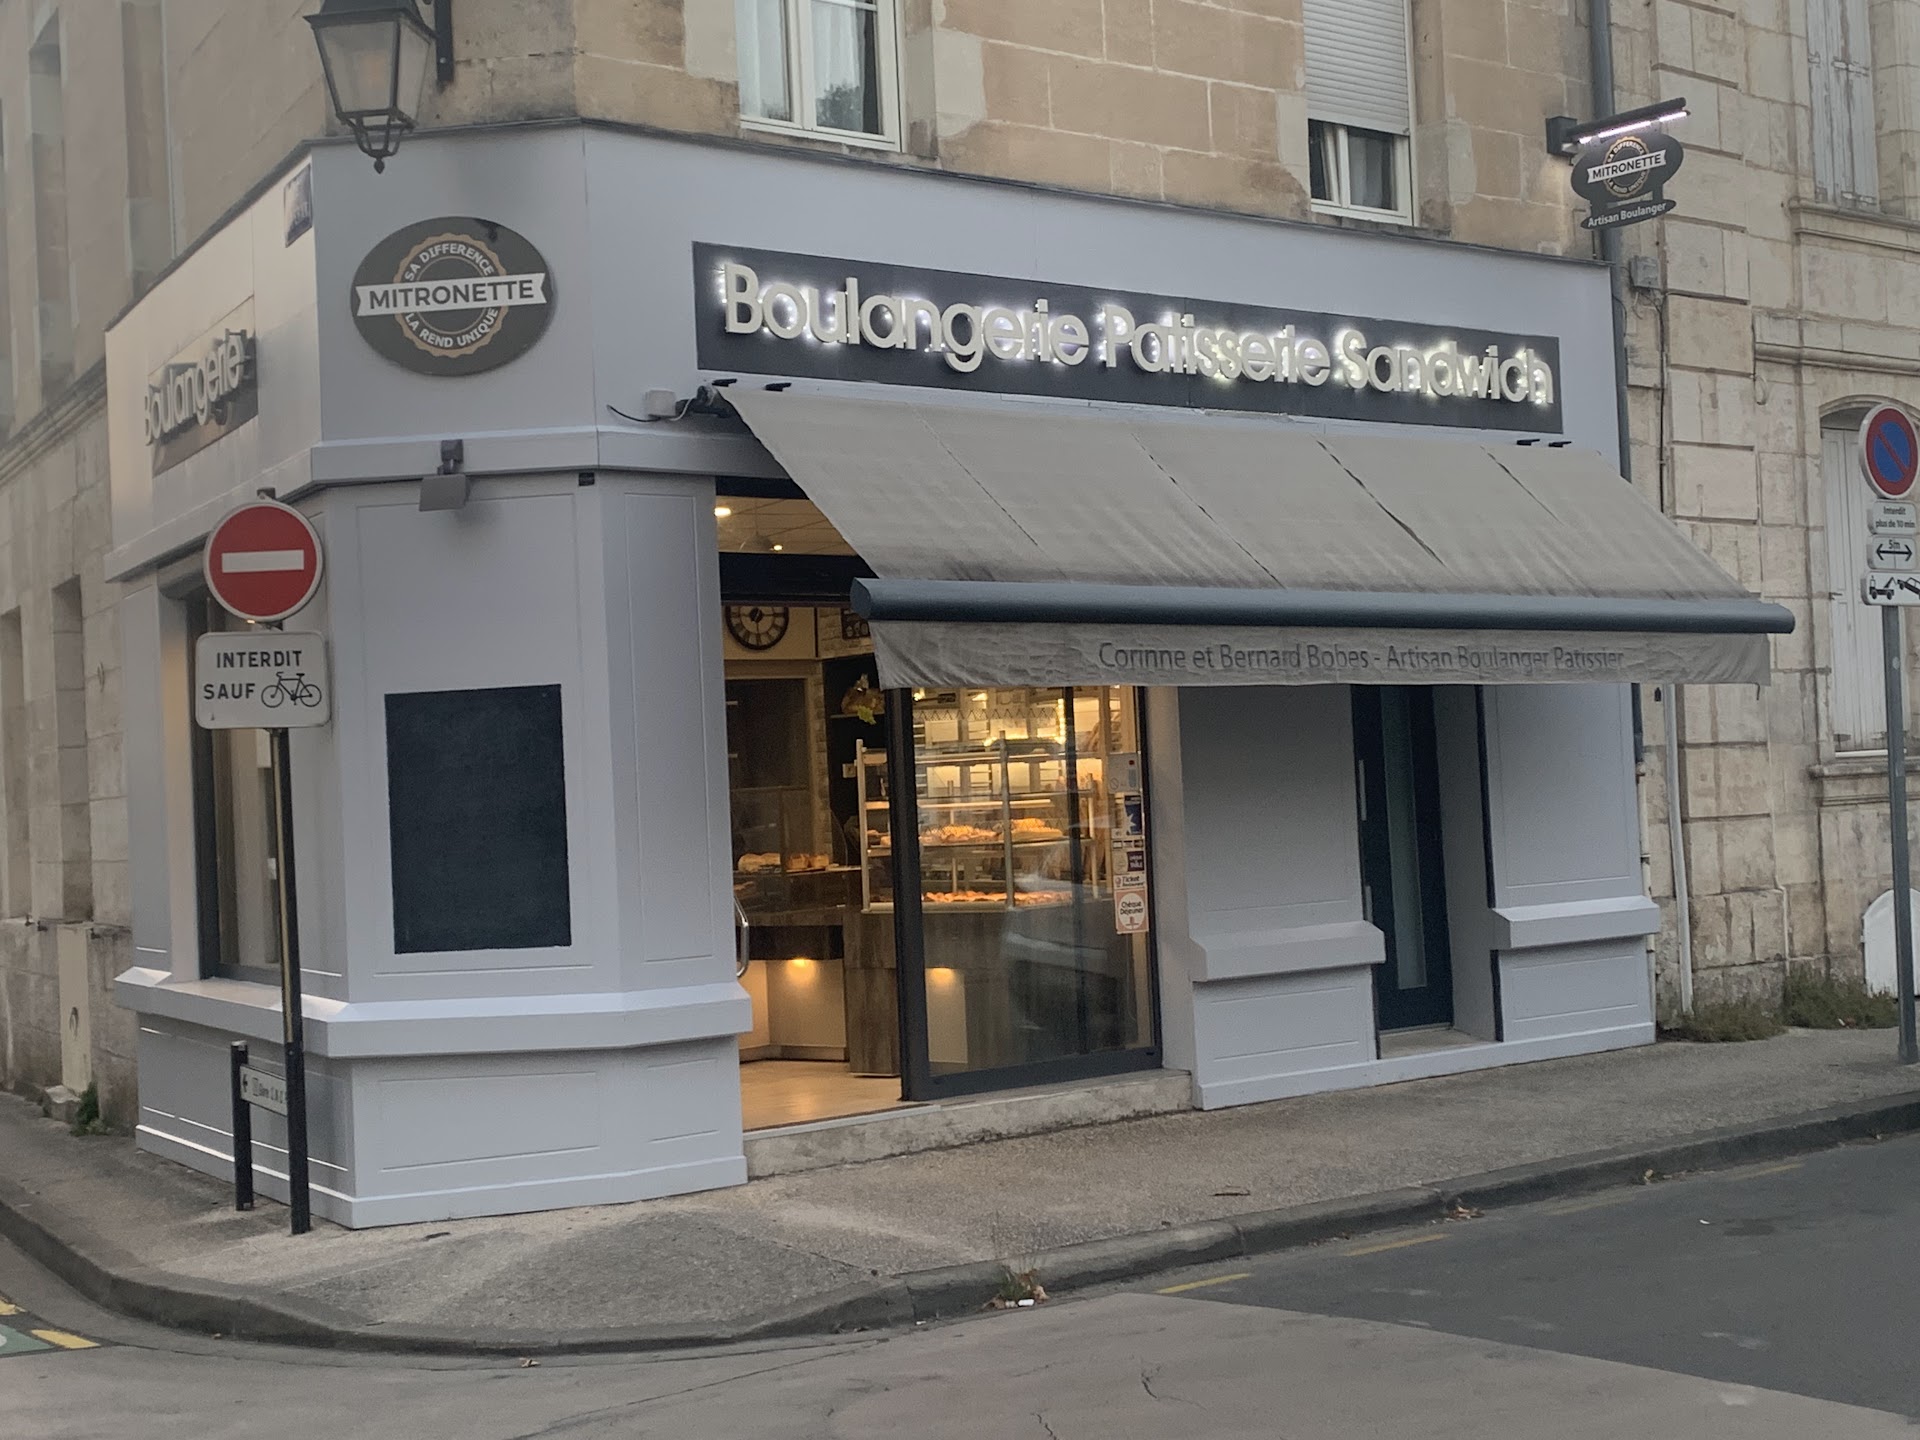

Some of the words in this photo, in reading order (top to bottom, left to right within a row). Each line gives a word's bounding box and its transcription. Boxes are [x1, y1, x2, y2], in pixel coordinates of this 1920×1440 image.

[1592, 154, 1661, 180] MITRONETTE
[1588, 213, 1619, 227] Artisan
[1621, 202, 1667, 219] Boulanger
[404, 262, 421, 282] SA
[419, 243, 495, 277] DIFFERENCE
[369, 279, 535, 310] MITRONETTE
[405, 312, 418, 331] LA
[420, 328, 454, 348] REND
[456, 307, 499, 347] UNIQUE
[724, 263, 1090, 373] Boulangerie
[1103, 304, 1331, 387] Patisserie
[1341, 329, 1554, 404] Sandwich
[216, 650, 303, 669] INTERDIT
[1099, 643, 1185, 668] Corinne
[1192, 646, 1215, 668] et
[1219, 644, 1300, 668] Bernard
[1306, 644, 1369, 669] Bobes
[1387, 645, 1451, 668] Artisan
[1457, 645, 1549, 675] Boulanger
[1553, 646, 1624, 669] Patissier
[203, 682, 256, 700] SAUF
[1122, 875, 1140, 883] Ticket
